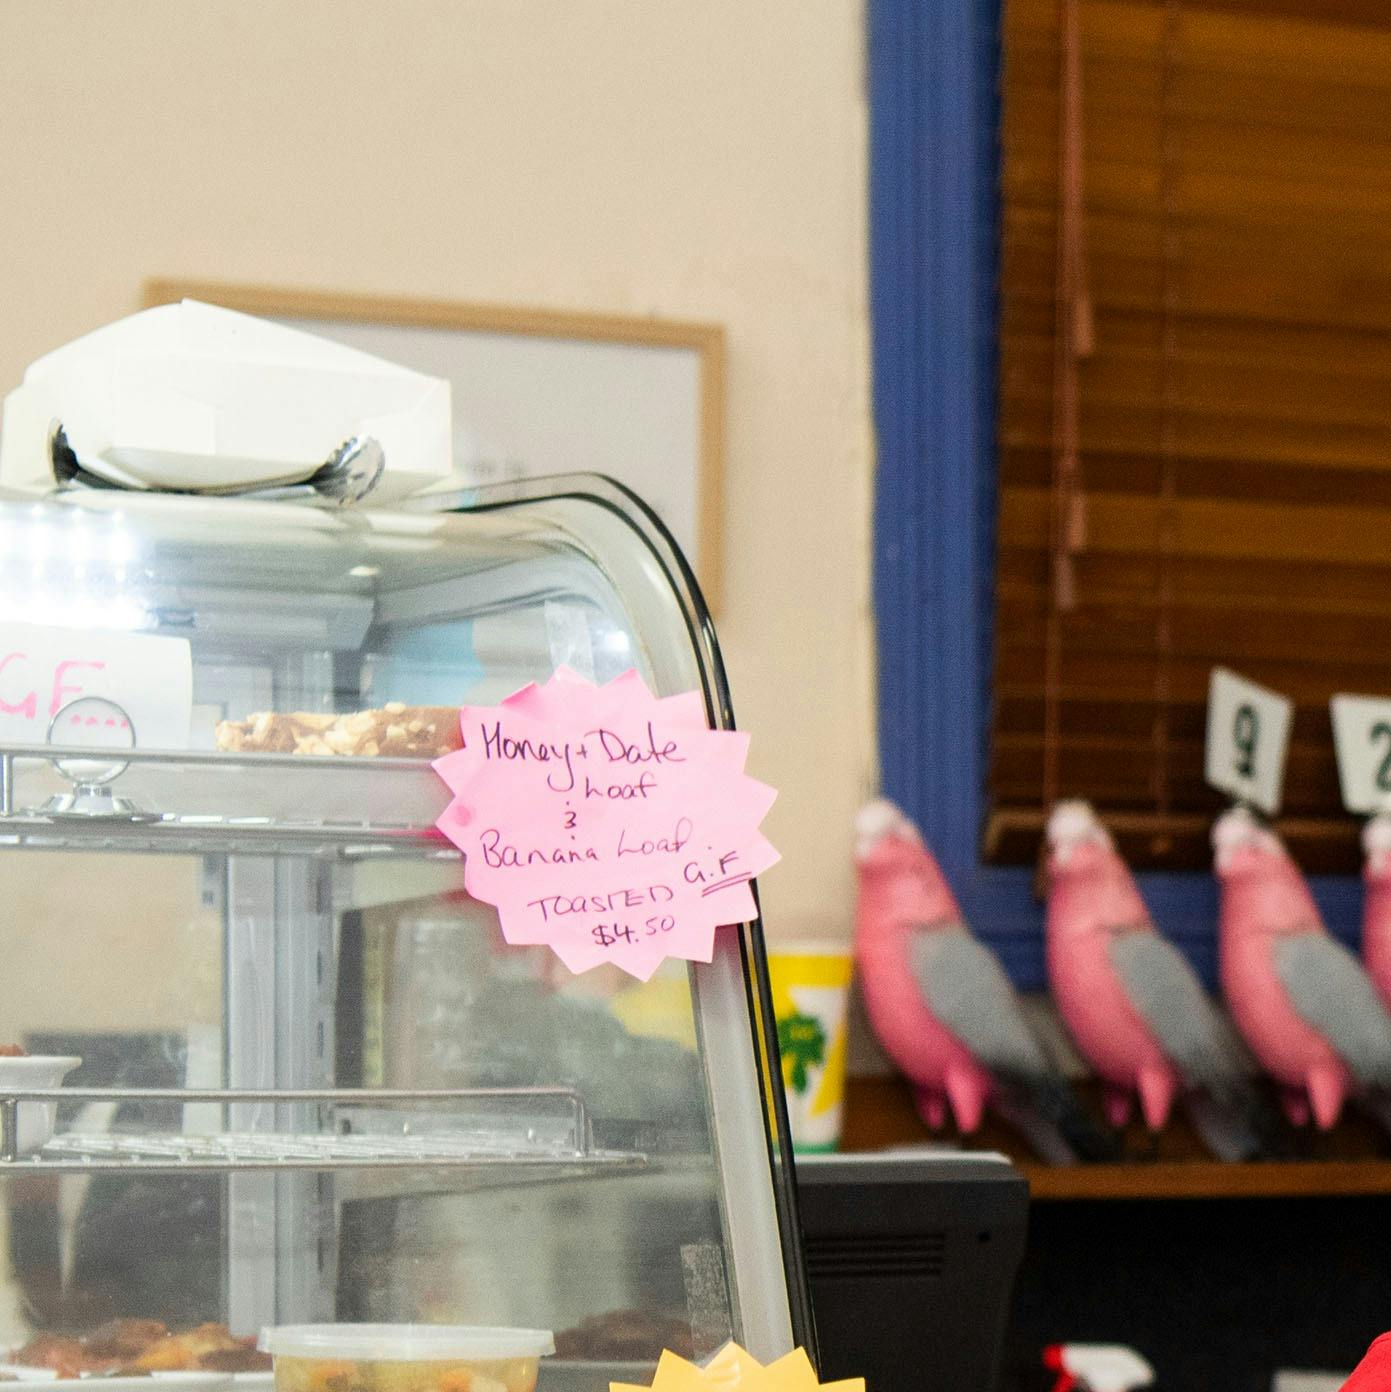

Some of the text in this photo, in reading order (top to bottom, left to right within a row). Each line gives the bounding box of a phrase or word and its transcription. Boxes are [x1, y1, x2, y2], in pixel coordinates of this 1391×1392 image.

[481, 721, 575, 793] Honey
[584, 721, 687, 765] Date
[1232, 703, 1261, 780] 9
[479, 829, 599, 868] Banana
[591, 915, 676, 947] $4.50
